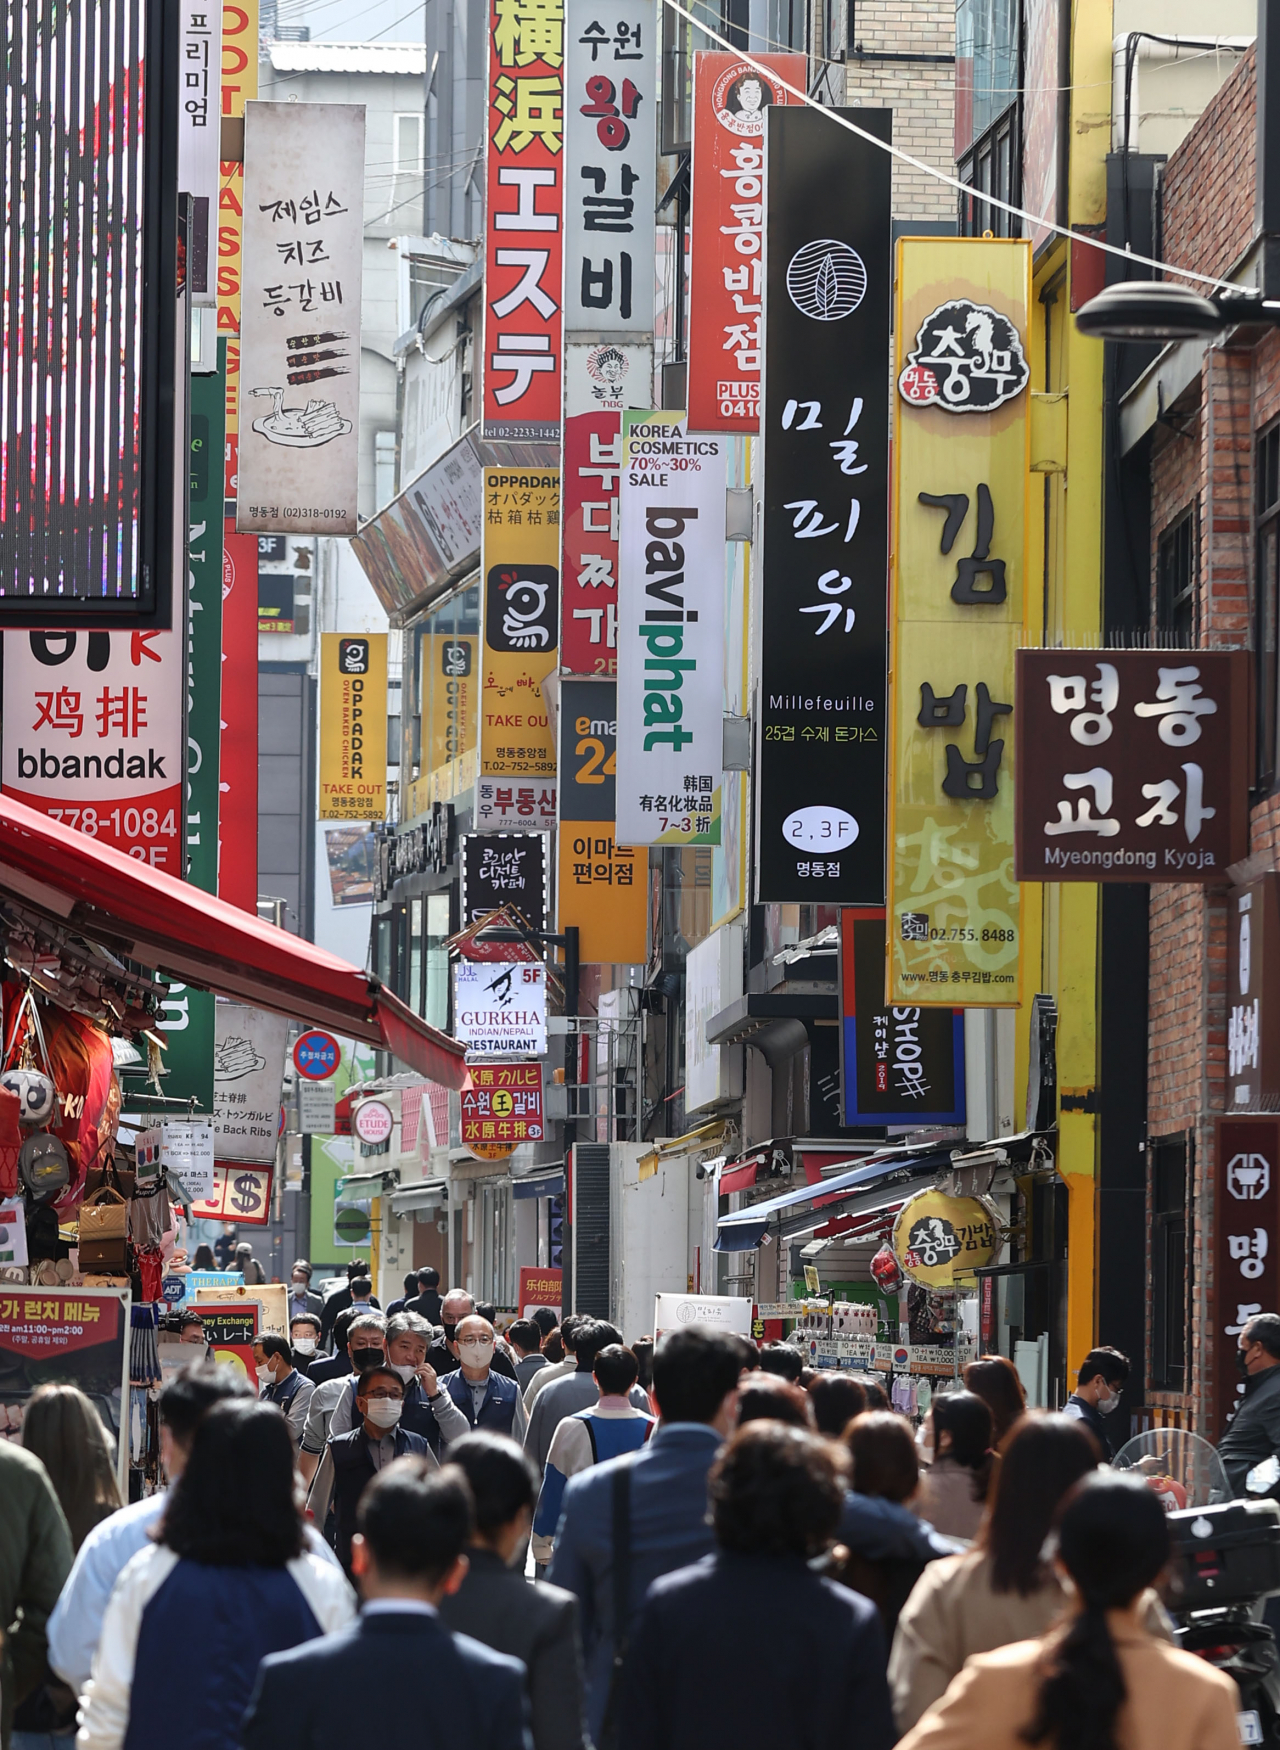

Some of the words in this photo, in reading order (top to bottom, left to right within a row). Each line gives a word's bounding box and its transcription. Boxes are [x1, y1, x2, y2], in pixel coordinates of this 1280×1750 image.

[579, 20, 645, 62] 수원
[184, 14, 212, 127] 프리미엄
[259, 190, 349, 225] 제임스
[276, 239, 330, 266] 치즈
[263, 278, 343, 317] 등갈비
[917, 326, 1018, 402] 충무
[591, 385, 624, 400] 놀부
[719, 384, 760, 399] PLUS
[904, 371, 938, 398] 명동
[485, 425, 497, 437] tel
[498, 427, 560, 439] 02-2233-1442
[630, 425, 682, 439] KOREA
[629, 441, 719, 456] COSMETICS
[630, 457, 702, 472] 70%~30%
[629, 473, 669, 487] SALE
[249, 506, 279, 519] 명동점
[283, 507, 347, 519] (02)318-0192
[781, 397, 869, 636] 밀피유
[638, 506, 699, 752] baviphat
[342, 680, 350, 704] OVEN
[769, 695, 875, 711] Millefeuille
[1046, 662, 1218, 748] 명동
[32, 686, 148, 738] 鸡排
[342, 707, 350, 737] BAKED
[351, 679, 364, 779] OPPADAK
[486, 715, 522, 727] TAKE
[765, 726, 795, 741] 25겹
[801, 727, 829, 742] 수제
[835, 727, 878, 742] 돈가스
[341, 739, 350, 778] CHICKEN
[496, 747, 547, 759] 명동중앙점
[18, 748, 167, 778] bbandak
[322, 784, 353, 794] TAKE
[357, 784, 383, 795] OUT
[683, 775, 714, 793] 韩国
[479, 785, 494, 818] 동우
[494, 788, 557, 816] 부동산
[639, 795, 713, 813] 有名化妆品
[1044, 762, 1216, 844] 교자
[322, 810, 383, 820] T.02-752-5892
[695, 816, 711, 833] 折
[482, 847, 526, 865] 코리안
[1044, 847, 1157, 869] Myeongdong
[1164, 849, 1216, 869] Kyoja
[479, 864, 520, 879] 디저트
[572, 862, 634, 886] 편의점
[796, 861, 841, 878] 명동점
[491, 876, 525, 890] 카페
[522, 968, 541, 983] 5F
[461, 1011, 541, 1025] GURKHA
[469, 1027, 534, 1036] INDIAN/NEPALI
[872, 1015, 890, 1059] 케이샵
[467, 1040, 537, 1050] RESTAURANT
[498, 1069, 538, 1085] カルビ
[463, 1091, 490, 1117] 수원
[513, 1090, 540, 1116] 갈비
[223, 1125, 249, 1135] Back
[251, 1127, 273, 1138] Ribs
[359, 1120, 389, 1128] ETUDE
[465, 1121, 527, 1139] 水原牛排
[530, 1126, 541, 1135] 3F
[956, 1222, 993, 1252] 김밥
[164, 1285, 182, 1294] ADT
[192, 1278, 239, 1286] THERAPY
[0, 1300, 19, 1319] 가
[24, 1301, 60, 1320] 런치
[63, 1302, 100, 1322] 메뉴
[217, 1317, 254, 1325] Exchange
[11, 1325, 83, 1335] am11:00~pm2:00
